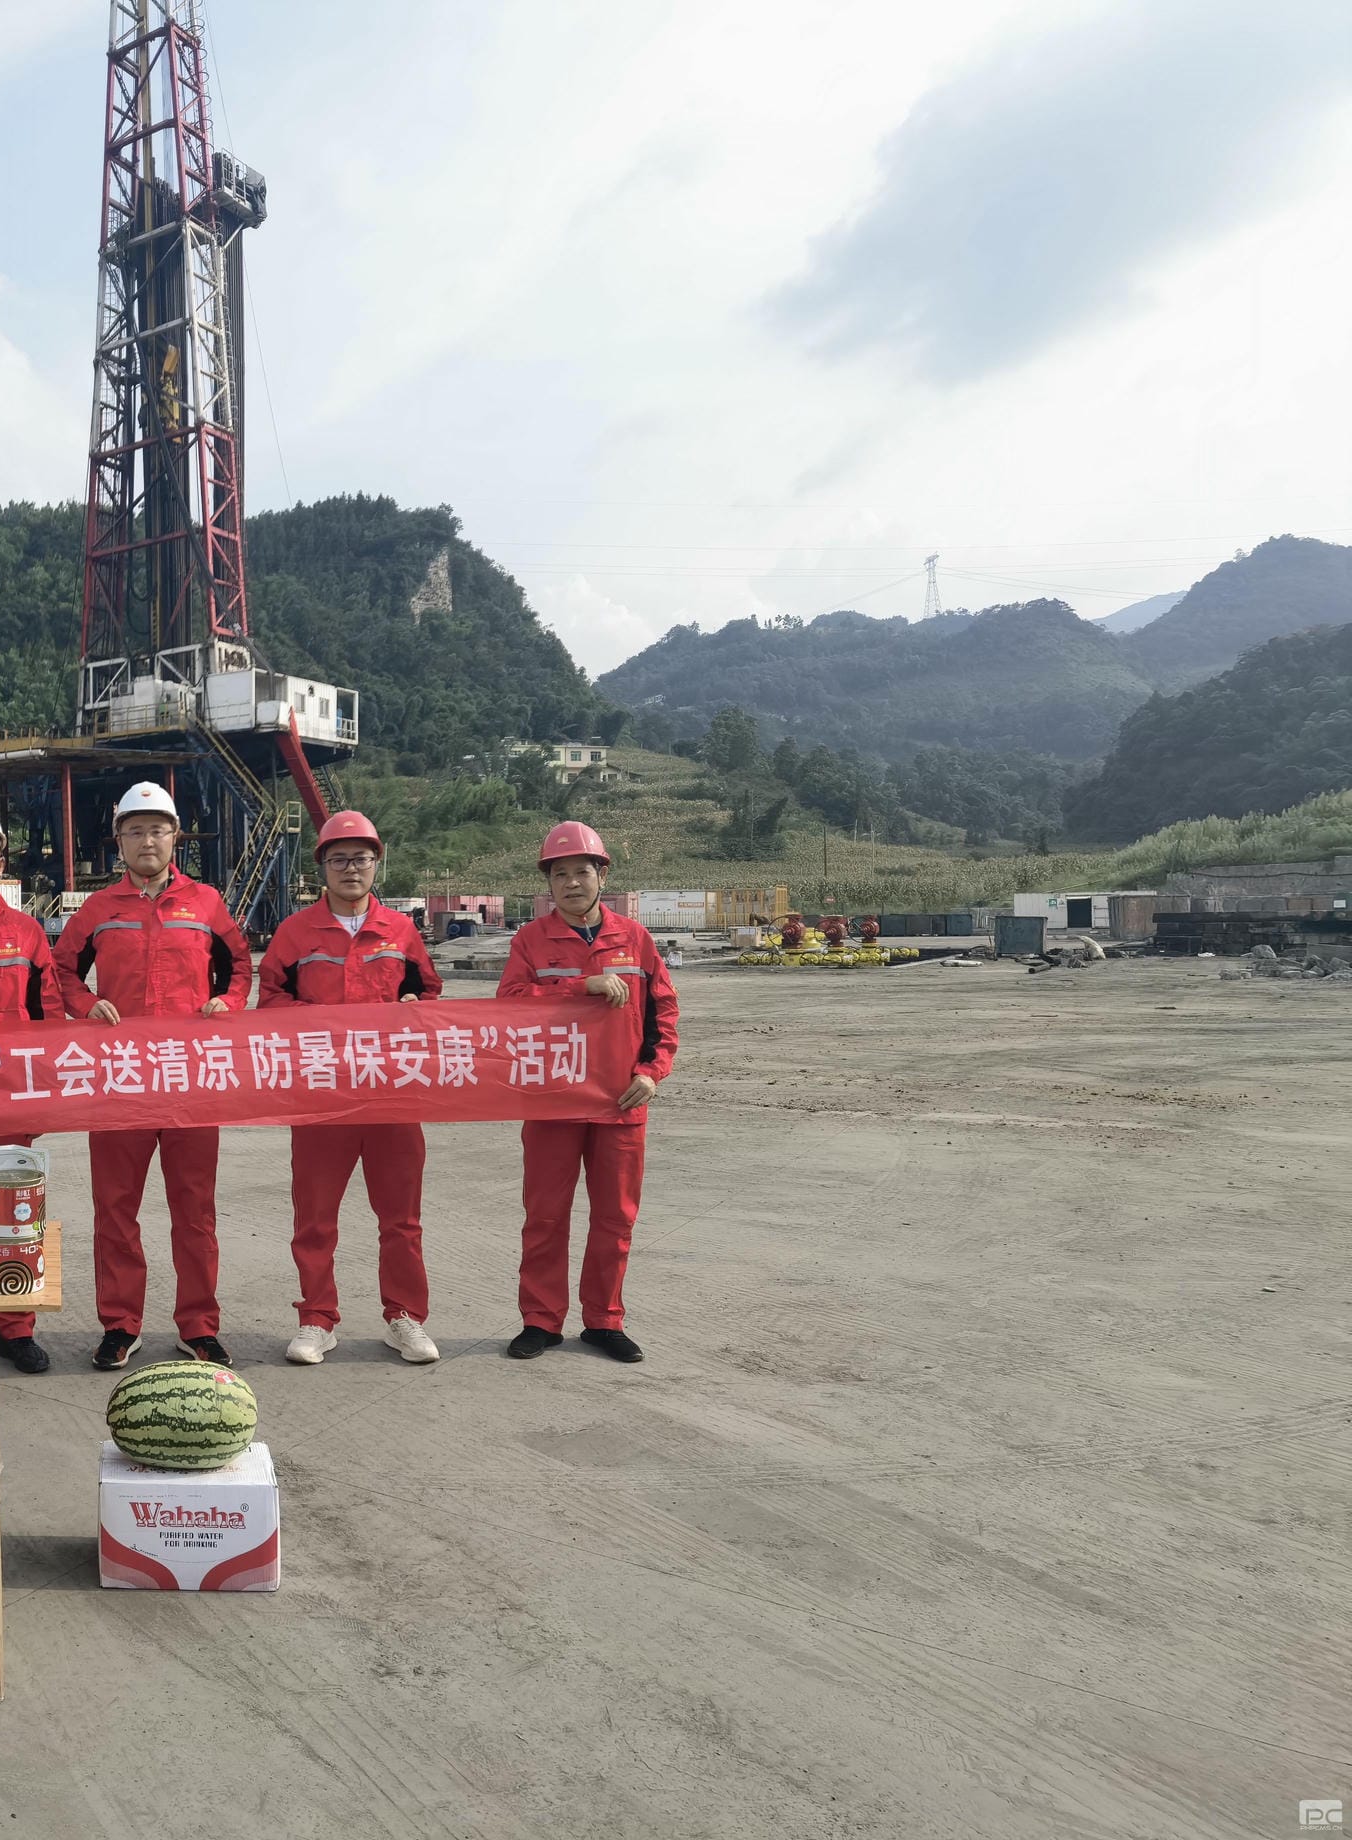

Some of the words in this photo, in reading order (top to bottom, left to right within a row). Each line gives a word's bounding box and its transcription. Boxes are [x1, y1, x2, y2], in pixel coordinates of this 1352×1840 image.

[129, 1501, 246, 1530] Wahaha
[159, 1531, 194, 1540] PURIFIED
[197, 1532, 224, 1540] WATER
[183, 1540, 218, 1549] DRINKING
